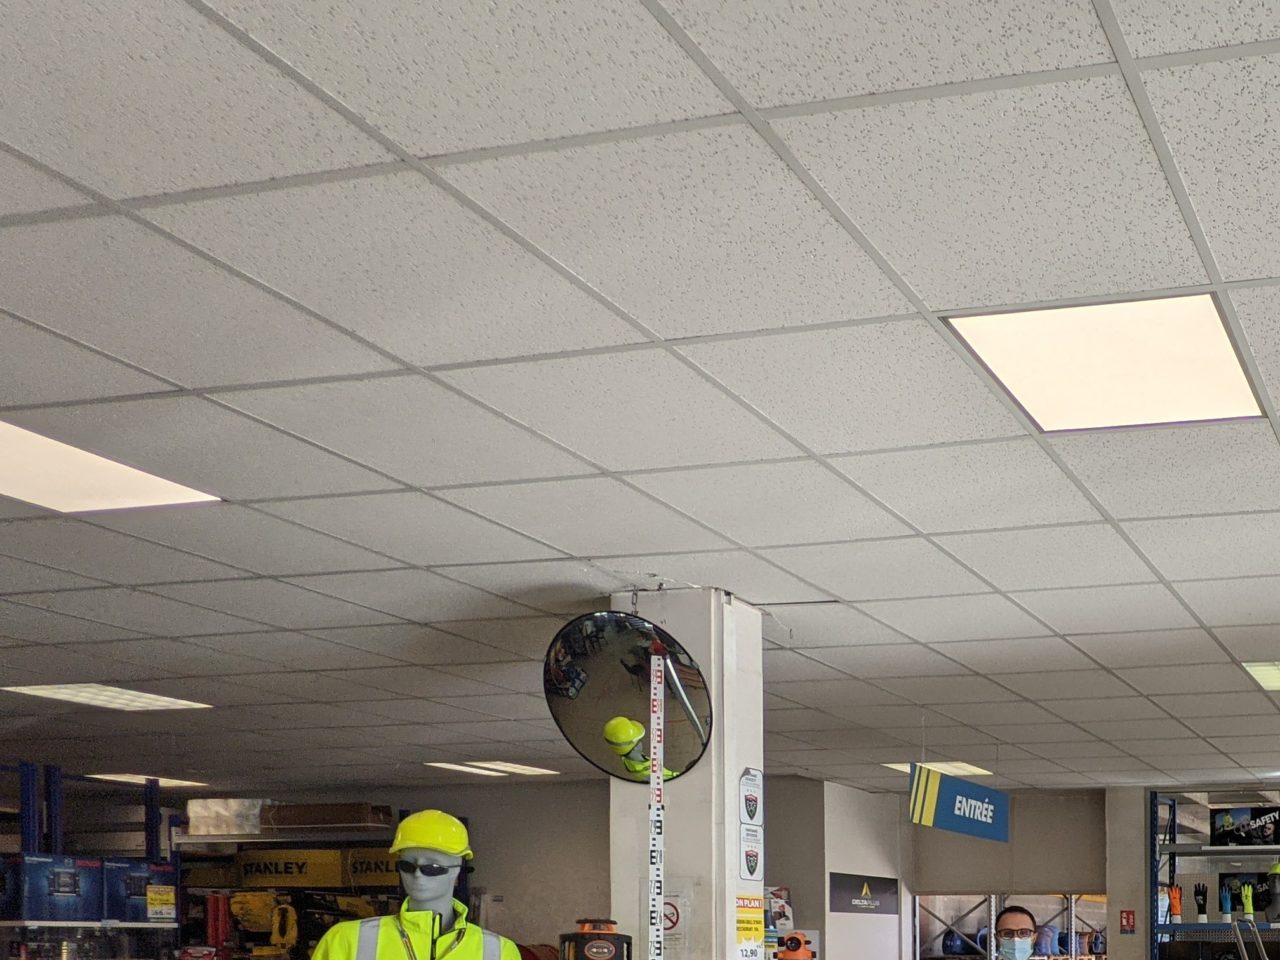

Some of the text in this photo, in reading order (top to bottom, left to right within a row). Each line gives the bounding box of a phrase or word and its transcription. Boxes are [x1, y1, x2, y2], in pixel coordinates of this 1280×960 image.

[954, 795, 994, 823] ENTRÉE
[1250, 811, 1280, 829] SAFETY
[243, 861, 307, 875] STANLEY
[352, 860, 400, 874] STANL
[740, 949, 758, 958] 12,90
